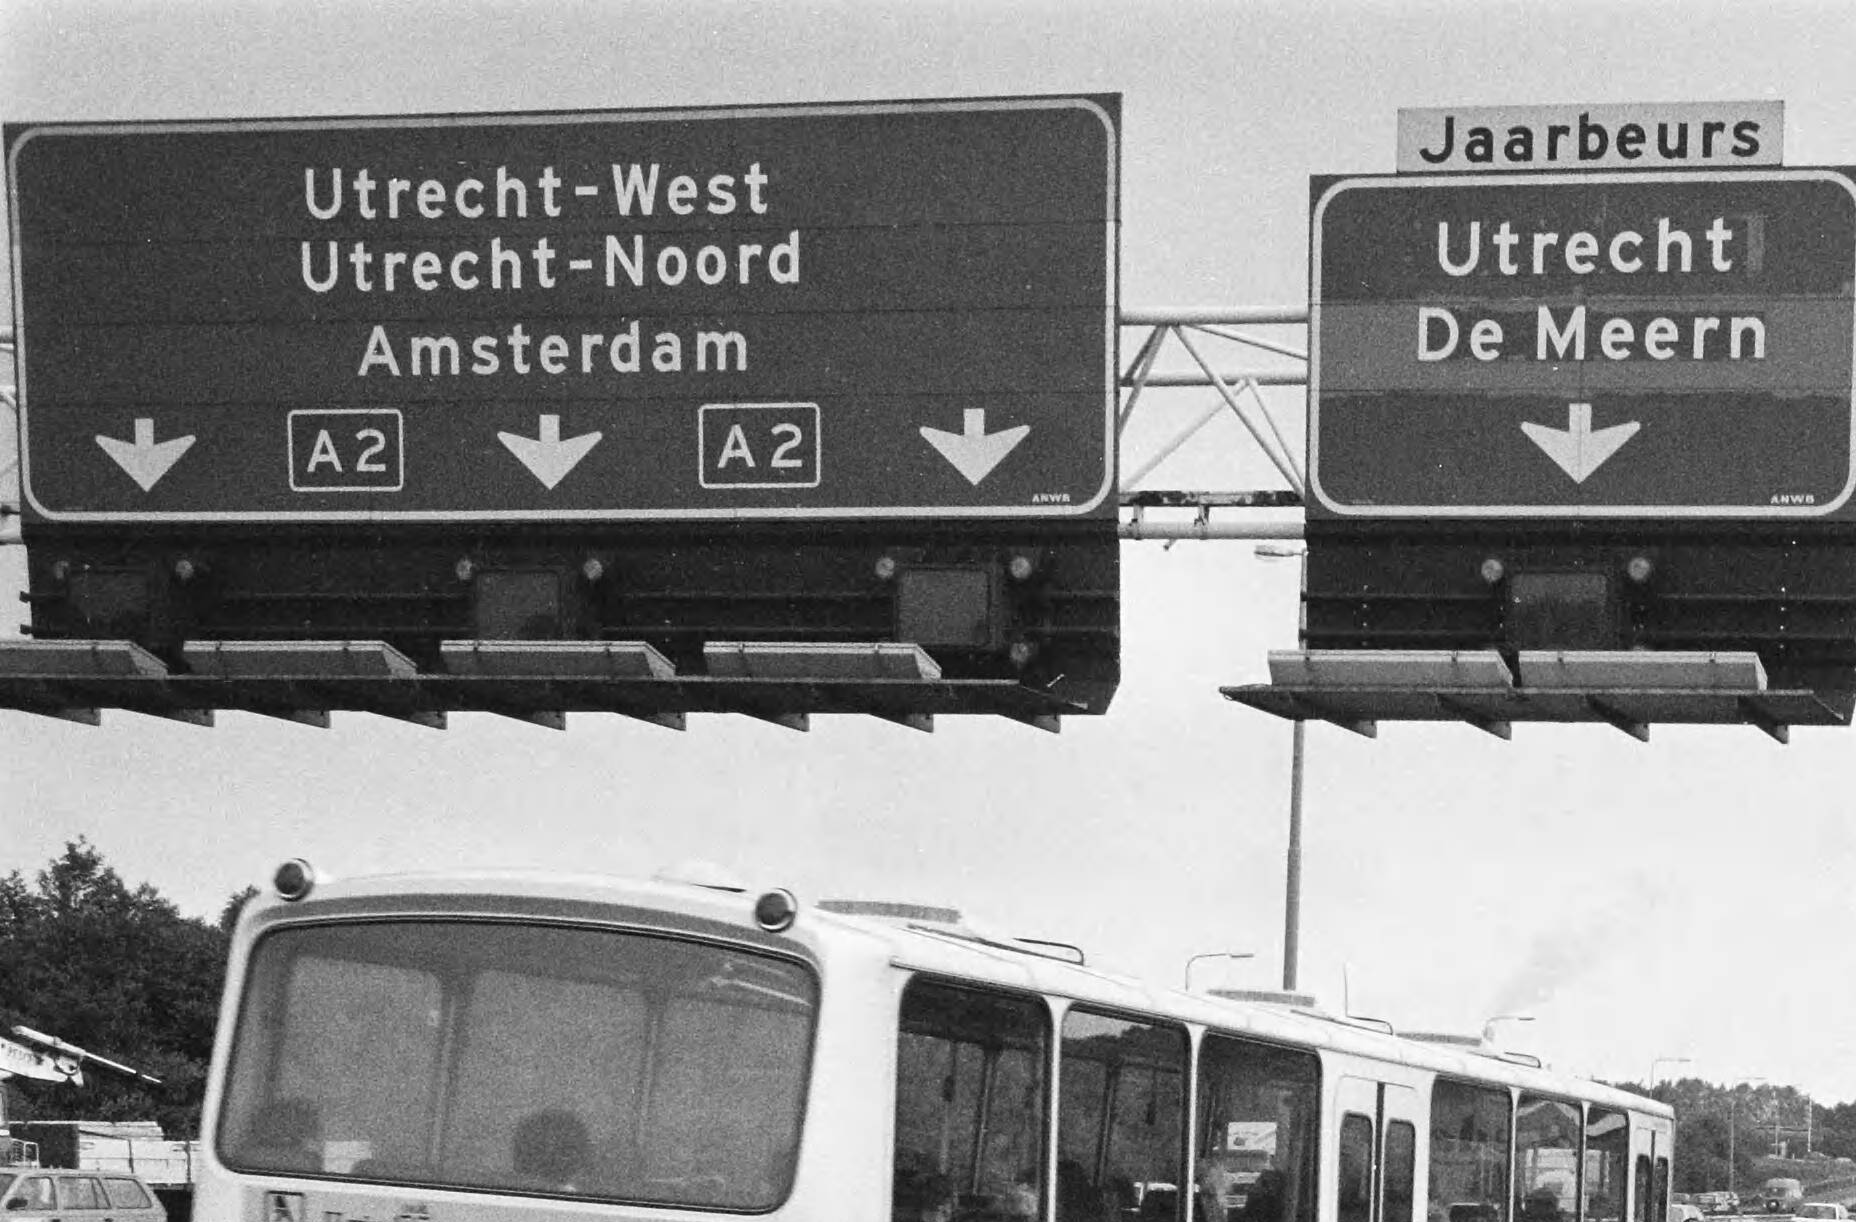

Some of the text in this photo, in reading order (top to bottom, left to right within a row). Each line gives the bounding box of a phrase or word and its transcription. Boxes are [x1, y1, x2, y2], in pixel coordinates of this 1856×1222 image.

[1419, 112, 1762, 165] Jaarbeurs
[305, 162, 770, 220] Utrecht-West
[301, 229, 801, 293] Utrecht-Noord
[1436, 216, 1734, 277] Utrecht
[358, 319, 749, 376] Amsterdam
[1418, 304, 1768, 363] De Meern
[306, 428, 388, 473] A2
[717, 422, 803, 469] A2
[1032, 493, 1071, 503] ANWB
[1770, 494, 1815, 504] ANWB
